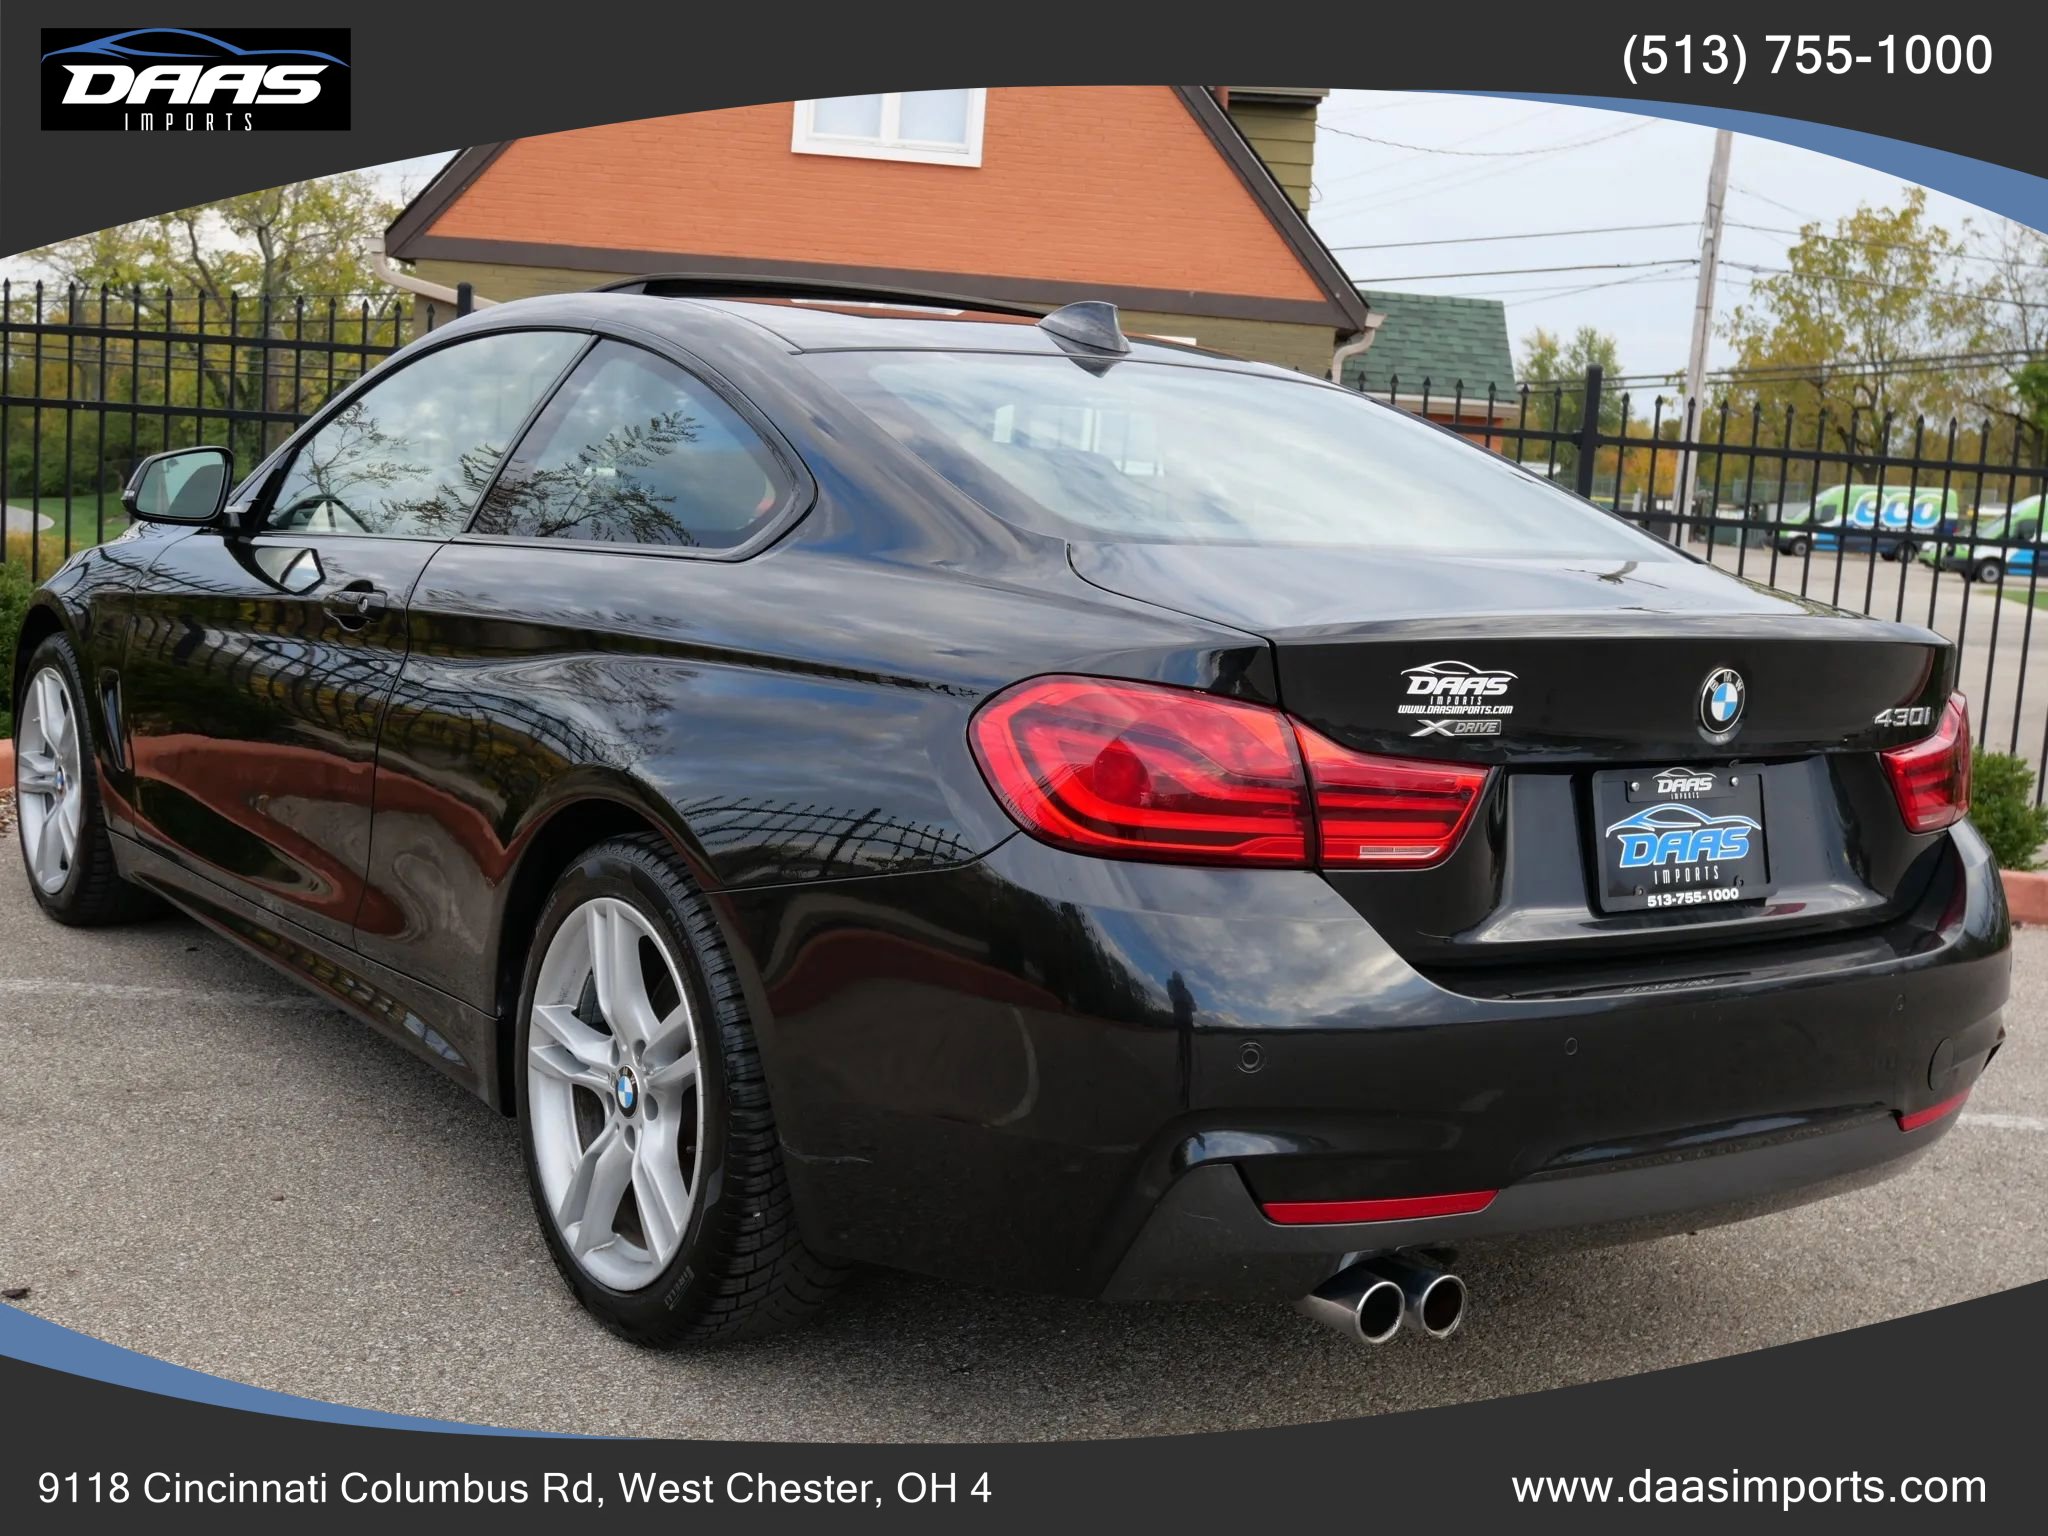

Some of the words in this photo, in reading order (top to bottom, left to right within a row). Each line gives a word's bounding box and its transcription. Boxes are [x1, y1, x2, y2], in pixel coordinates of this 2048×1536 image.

[1406, 675, 1513, 695] DAAS
[1397, 705, 1514, 715] WWW.DAASIMPORTS.COM
[1430, 696, 1483, 706] IMPORTS
[1657, 777, 1713, 793] DAAS
[1617, 826, 1752, 868] DAAS
[1654, 865, 1719, 885] IMPORTS
[1647, 887, 1740, 907] 513-755-1000
